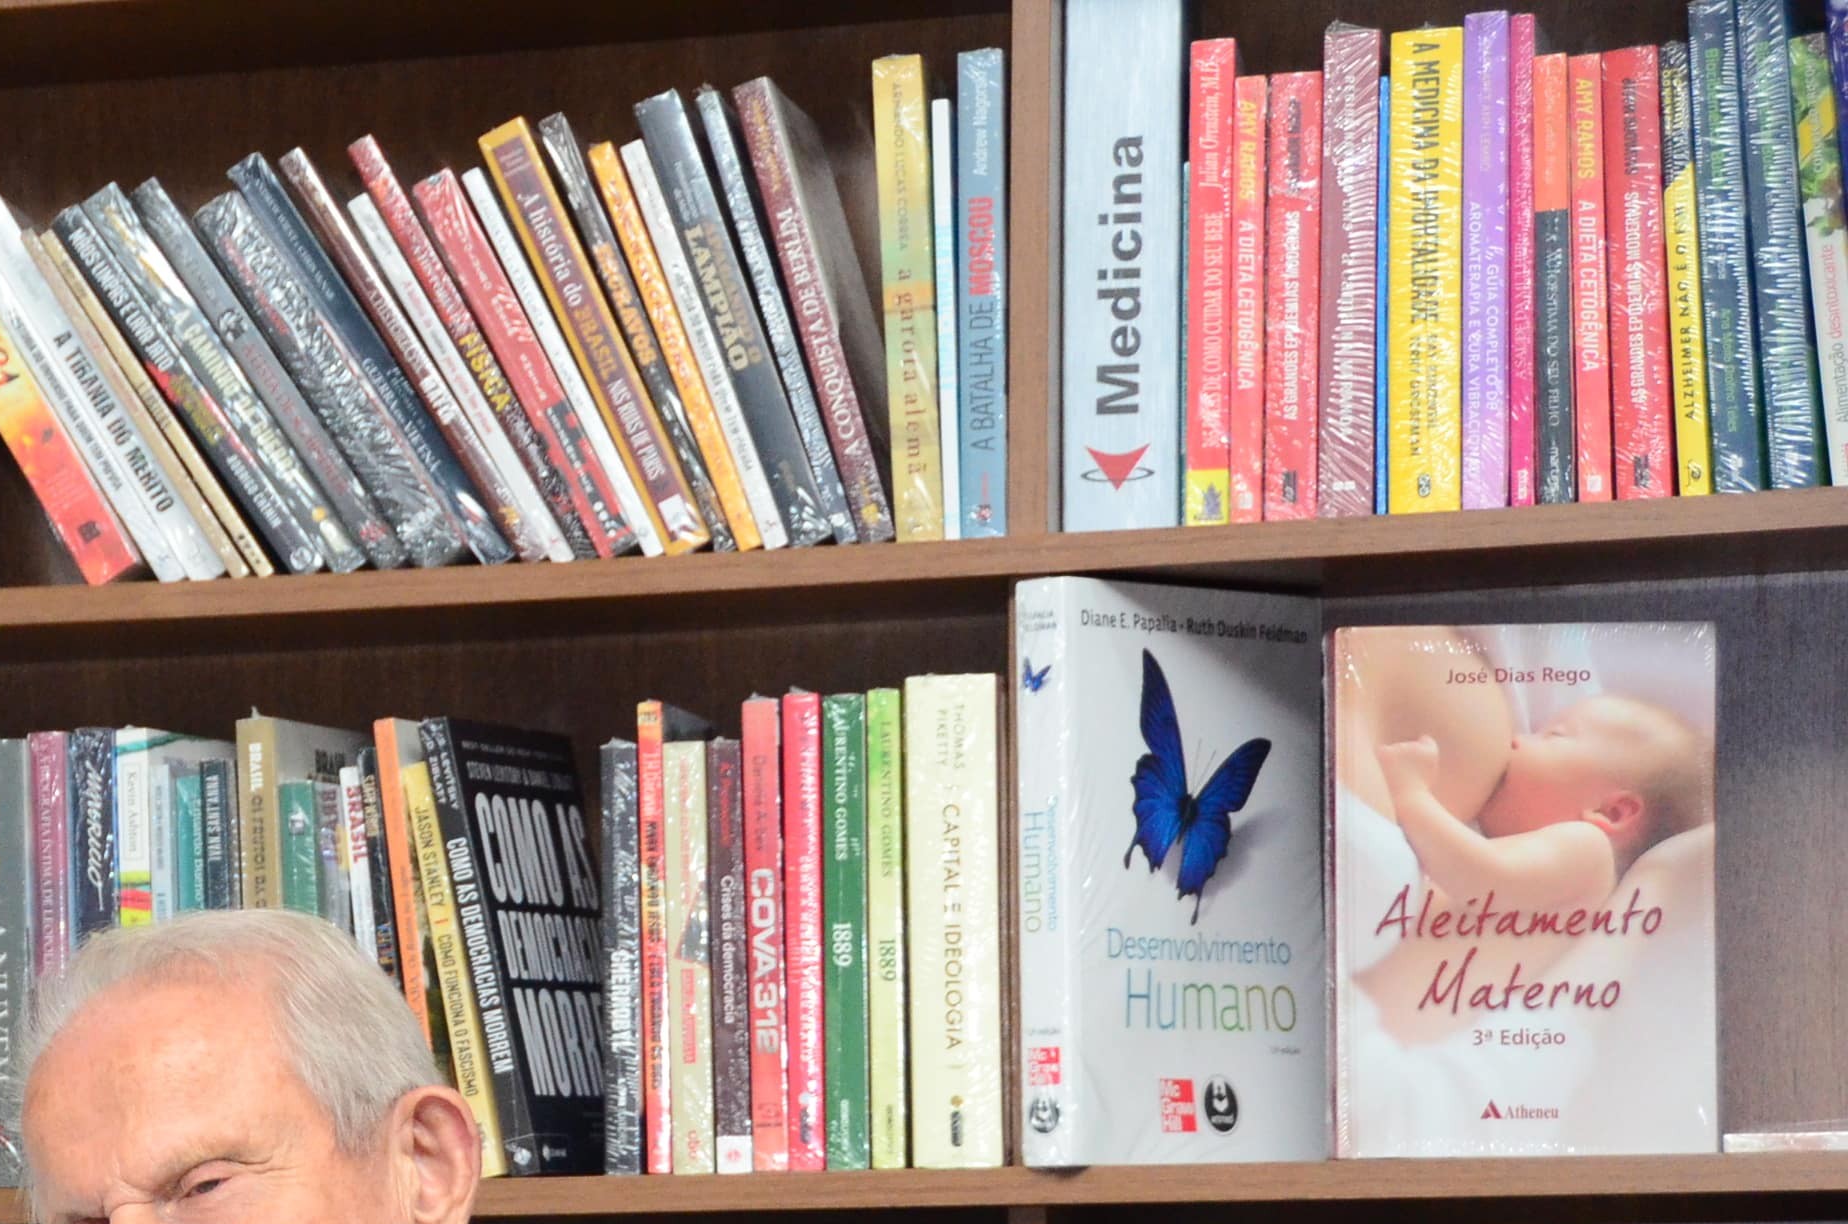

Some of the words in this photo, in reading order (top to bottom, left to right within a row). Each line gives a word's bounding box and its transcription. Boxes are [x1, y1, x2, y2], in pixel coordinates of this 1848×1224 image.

[1575, 78, 1595, 113] AMY
[1576, 118, 1596, 180] RAMOS
[1579, 199, 1598, 211] A
[968, 196, 994, 296] MOSCOU
[1578, 215, 1599, 265] DIETA
[682, 222, 750, 372] LAMPIÃO
[1096, 135, 1145, 415] Medicina
[969, 302, 993, 329] DE
[1580, 267, 1601, 372] CETOGÊNICA
[971, 336, 995, 430] BATALHA
[972, 435, 995, 451] A
[1080, 608, 1116, 627] Diane
[1187, 616, 1213, 636] Ruth
[1217, 618, 1256, 639] Duskin
[1259, 622, 1308, 644] Feldman
[1445, 665, 1487, 686] José
[1492, 666, 1536, 685] Dias
[1541, 665, 1592, 688] Rego
[206, 775, 221, 838] SANT'ANNA
[413, 805, 433, 851] JASON
[209, 838, 222, 862] IVAN
[444, 837, 469, 882] COMO
[422, 853, 445, 908] STANLEY
[456, 882, 473, 904] AS
[720, 875, 735, 920] Crises
[721, 922, 735, 939] da
[751, 868, 775, 977] COVA
[1375, 884, 1664, 940] Aleitamento
[461, 907, 499, 1008] DEMOCRACIAS
[831, 921, 851, 968] 1889
[1106, 927, 1292, 966] Desenvolvimento
[609, 950, 633, 1052] CHERNOBYL
[721, 942, 737, 1025] democracia
[1125, 968, 1298, 1034] Humano
[1417, 947, 1622, 1014] Materno
[479, 1010, 514, 1075] MORREM
[754, 982, 779, 1053] 312
[1504, 1103, 1560, 1121] Atheneu
